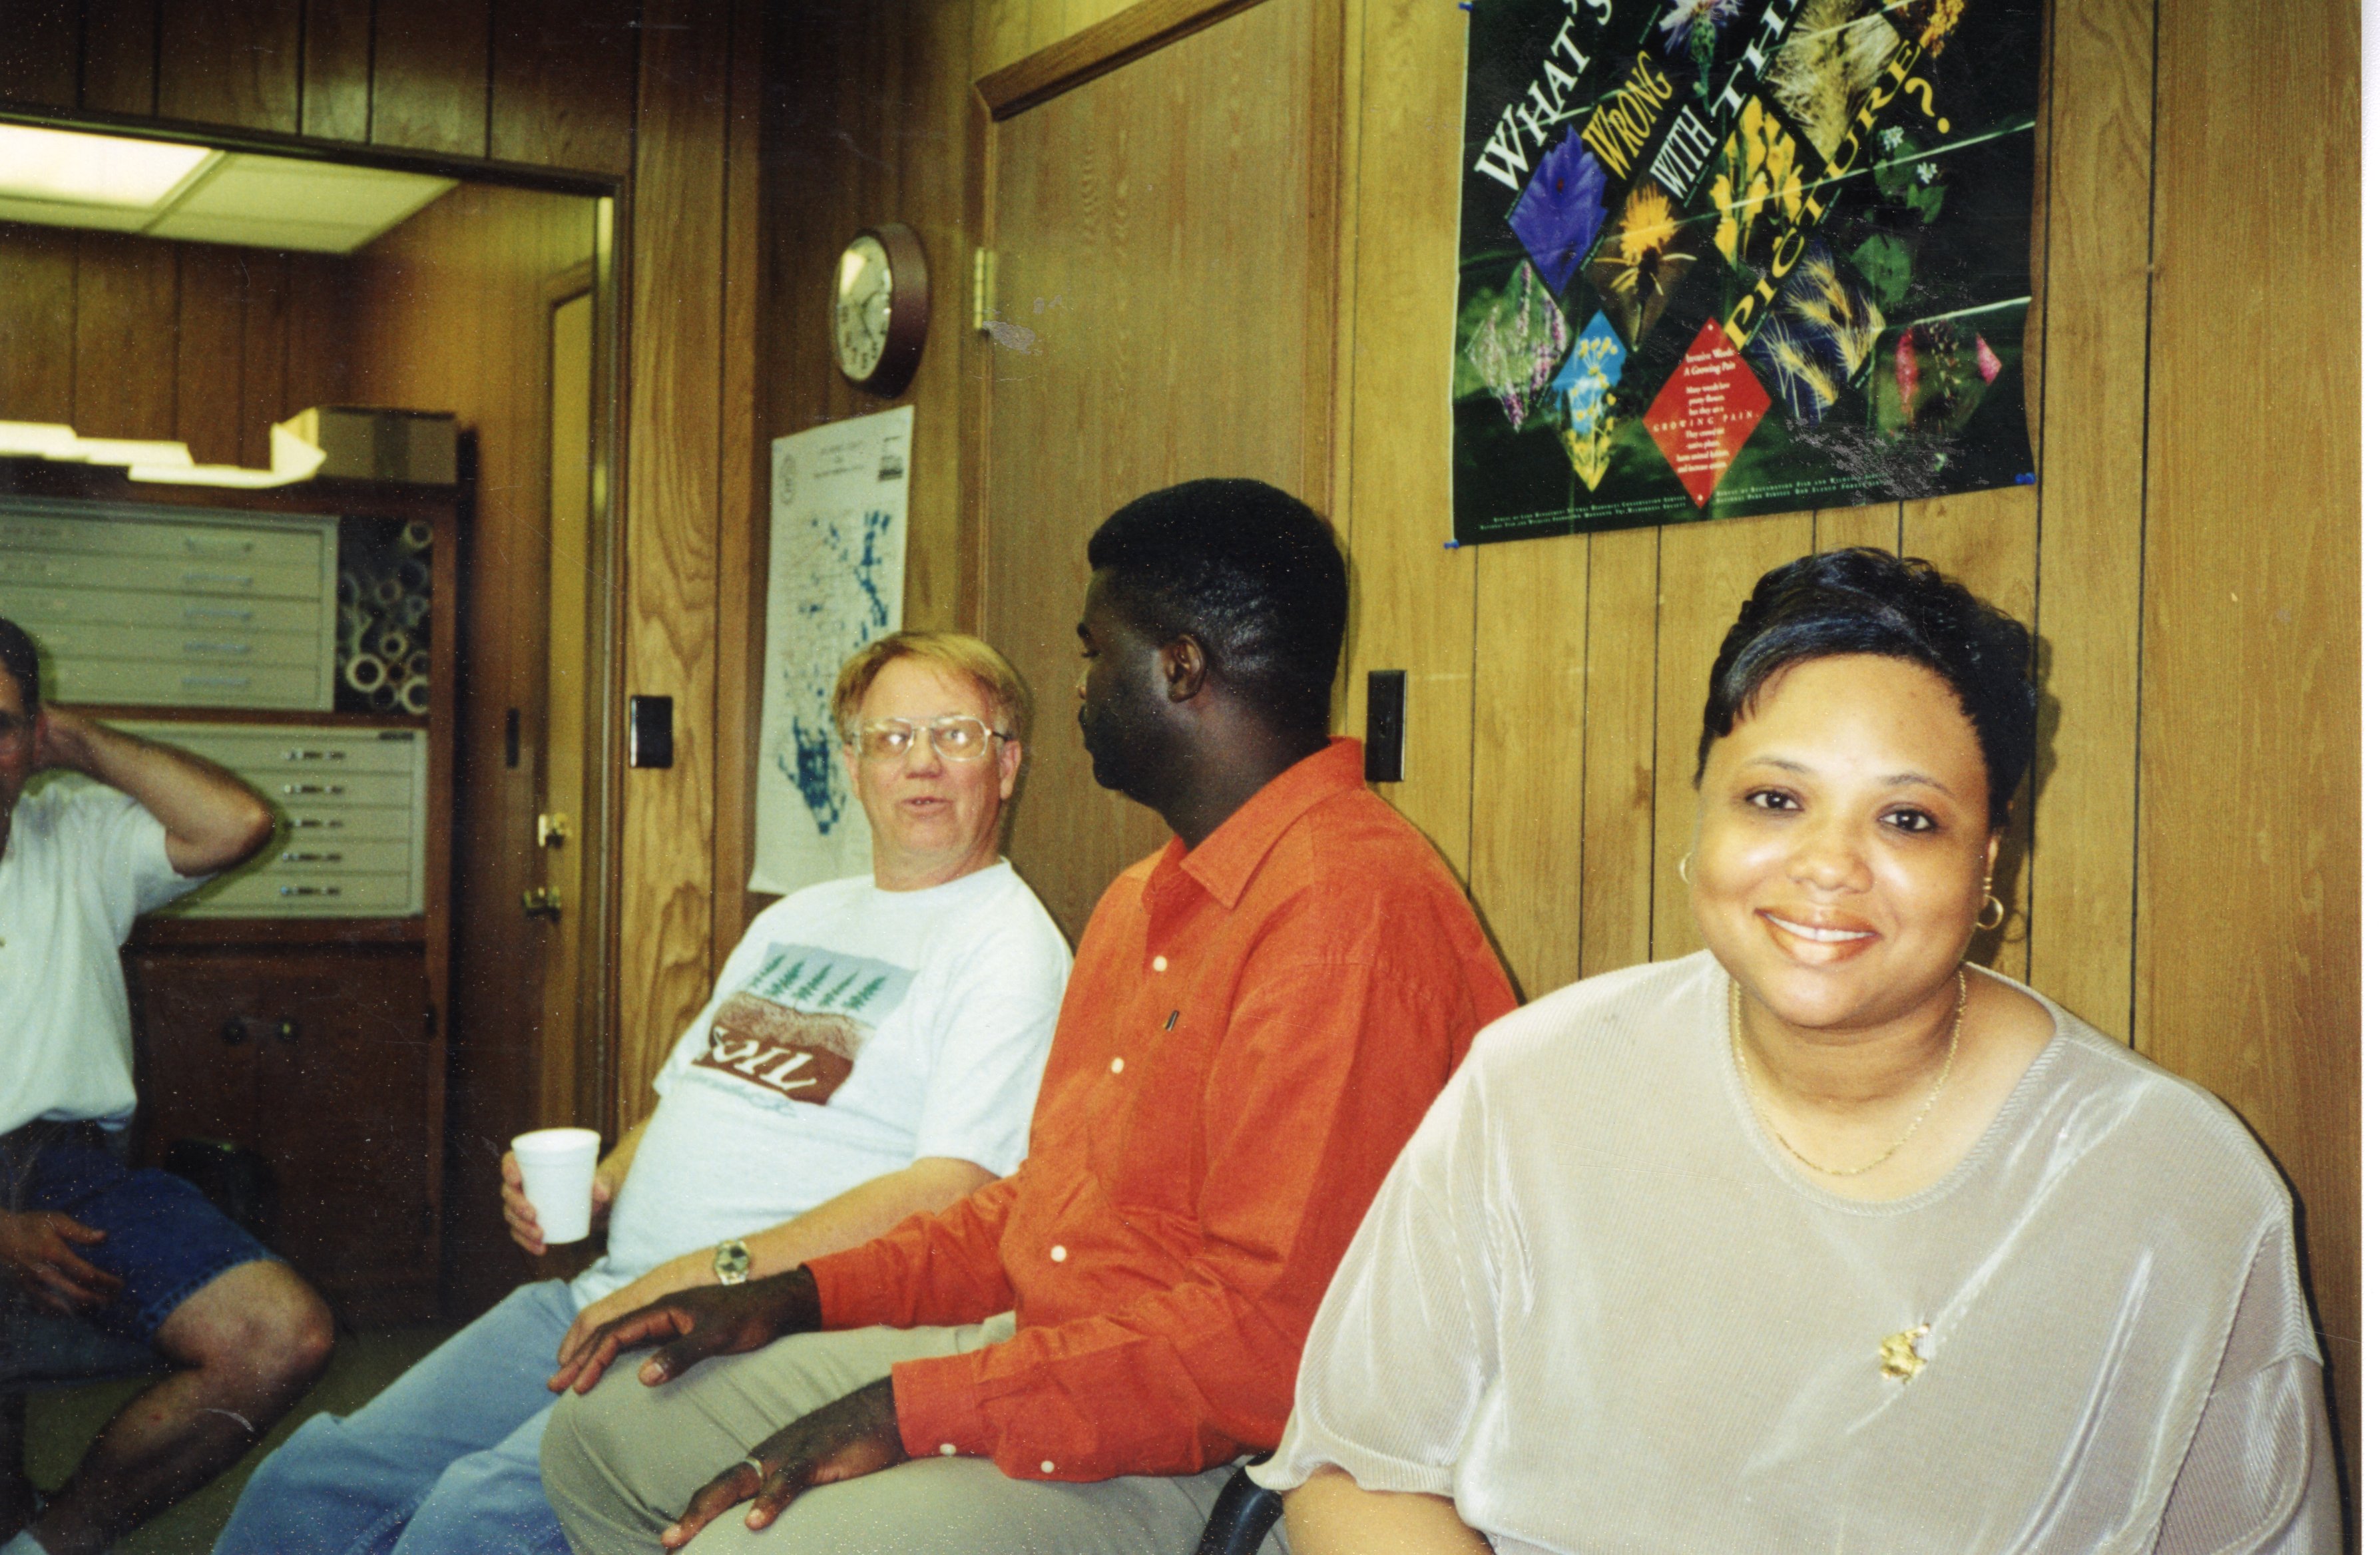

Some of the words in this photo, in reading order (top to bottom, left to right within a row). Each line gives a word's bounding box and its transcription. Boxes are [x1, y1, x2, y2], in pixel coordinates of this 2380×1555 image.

[1581, 51, 1673, 180] WRONG
[1649, 105, 1718, 199] WITH
[1710, 0, 1797, 118] TH
[1653, 417, 1715, 432] GROWING
